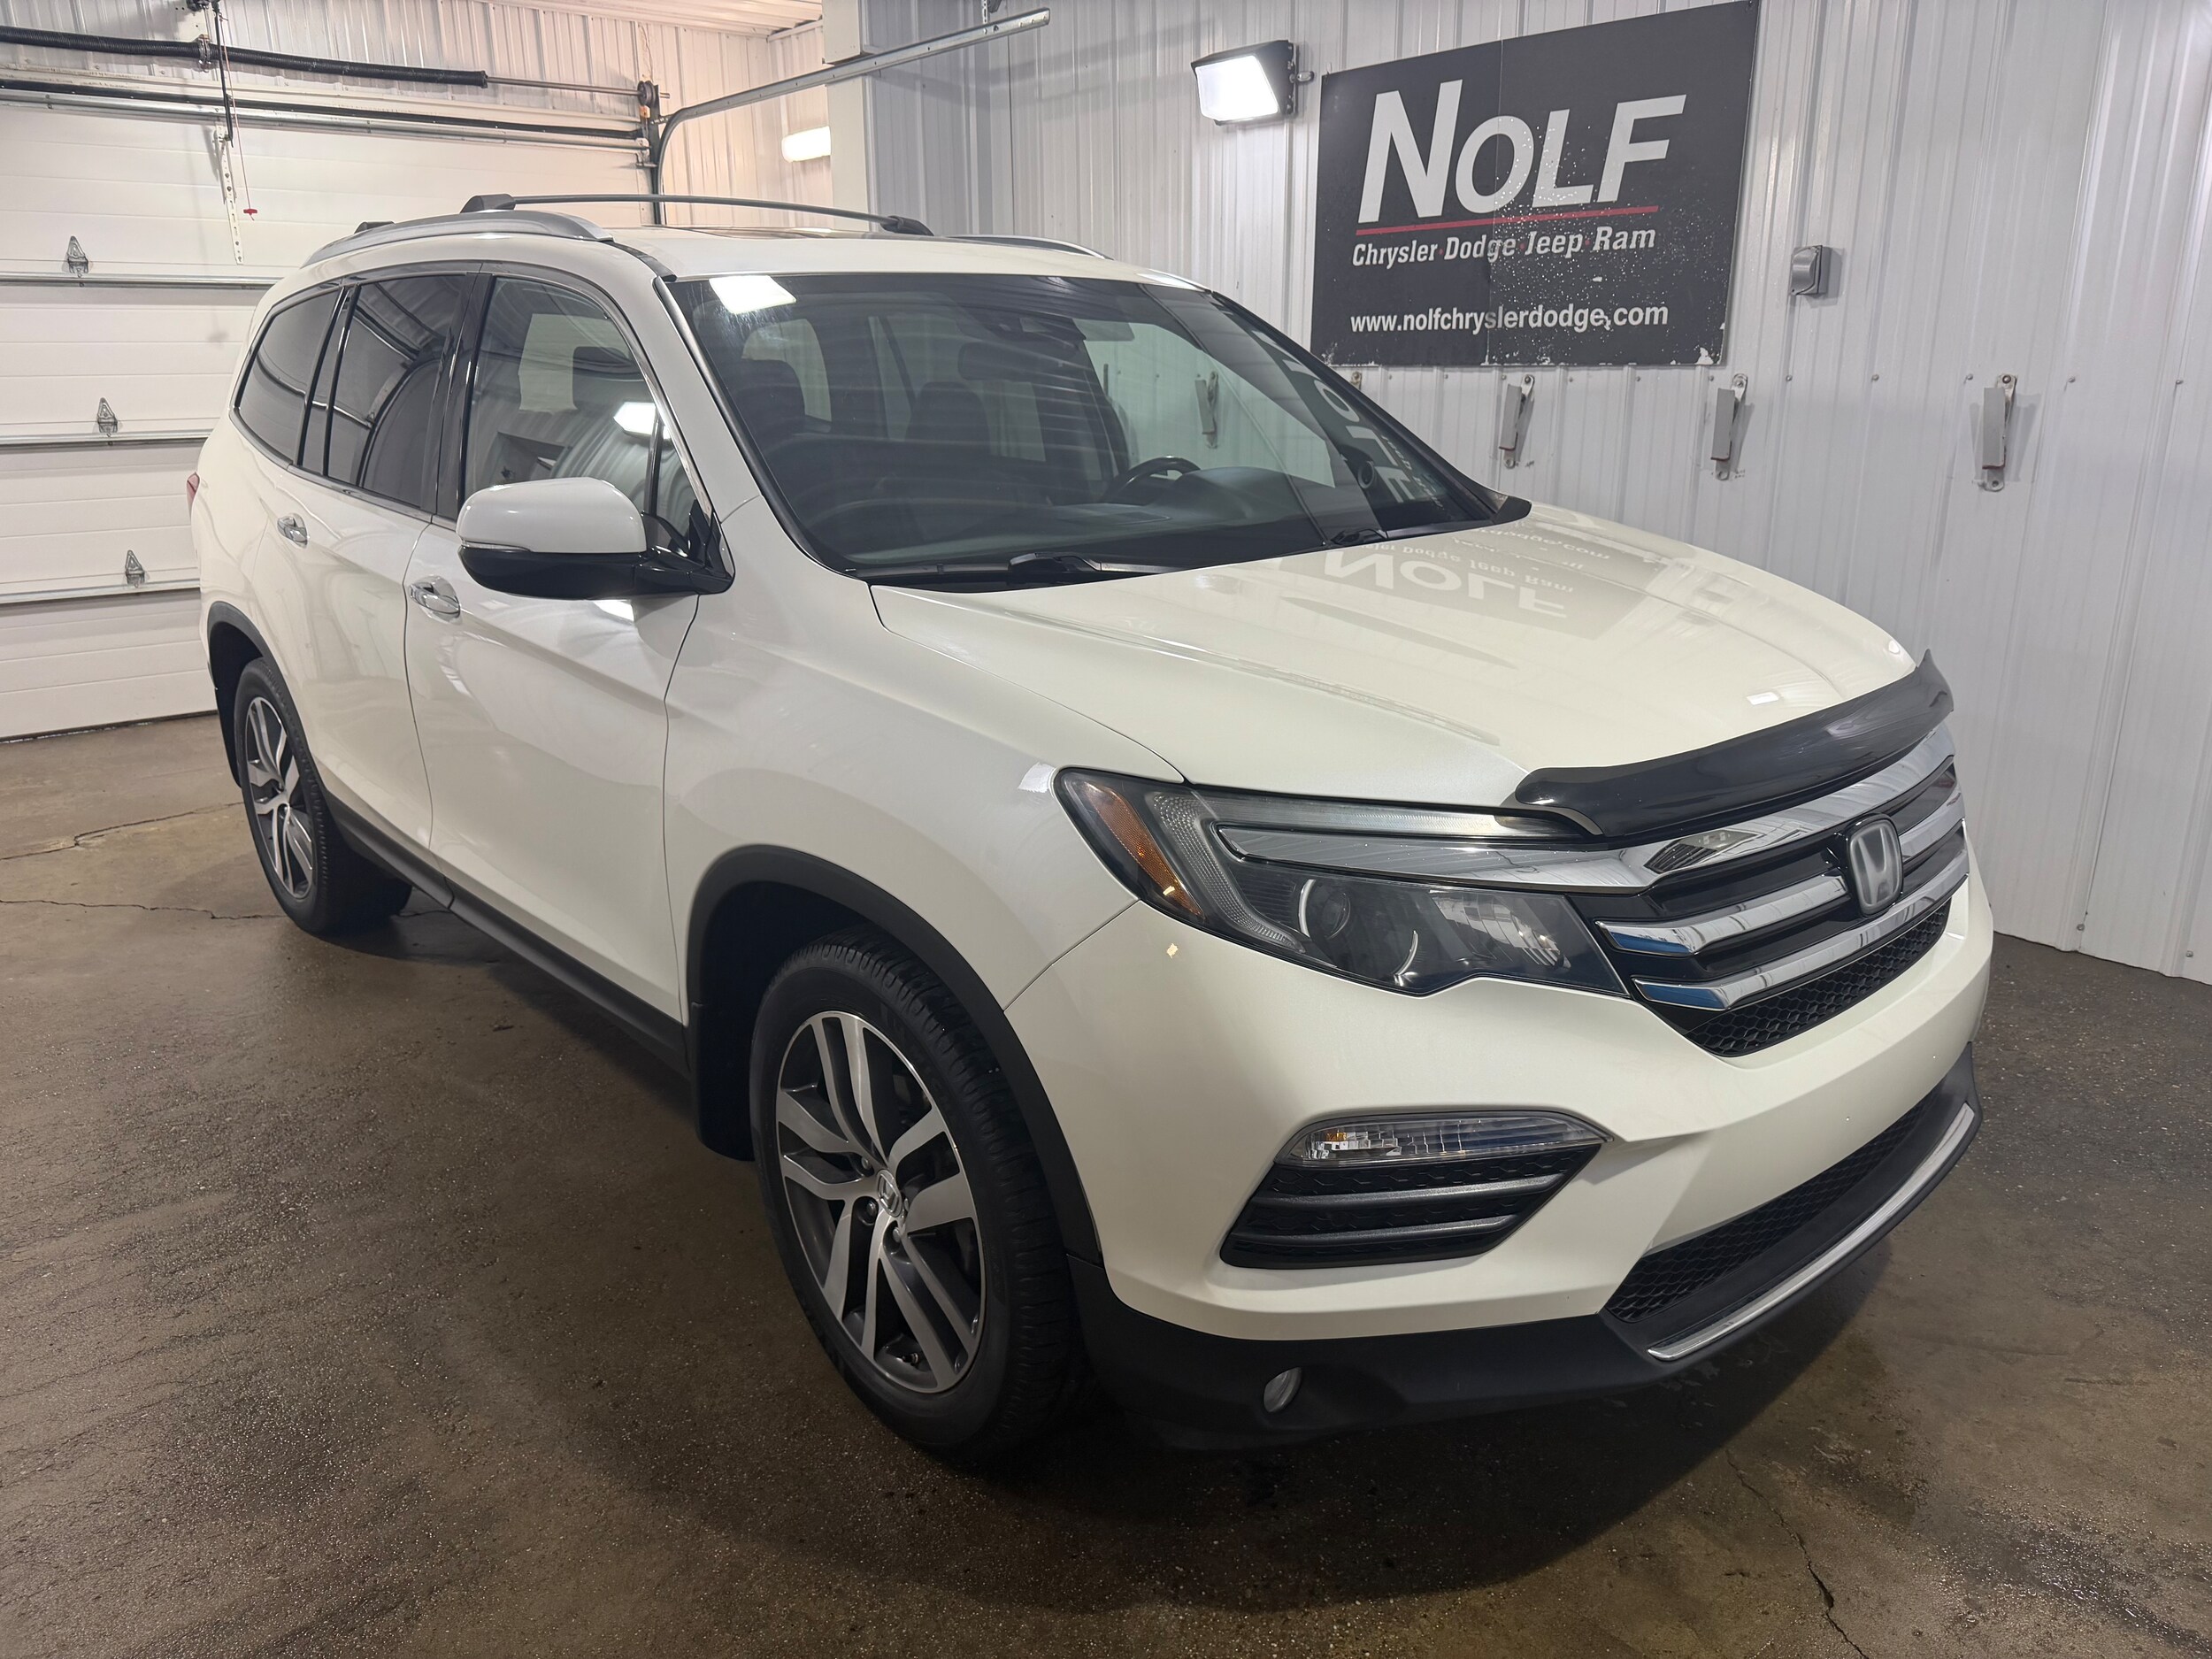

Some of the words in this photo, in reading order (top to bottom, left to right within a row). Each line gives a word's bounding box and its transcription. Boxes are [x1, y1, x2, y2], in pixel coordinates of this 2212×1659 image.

[1358, 79, 1686, 224] NOLF
[1352, 239, 1439, 269] Chrysler
[1444, 234, 1517, 262] Dodge
[1525, 231, 1583, 258] Jeep
[1593, 226, 1656, 251] Ram
[1350, 303, 1669, 334] www.nolfchryslerdodge.com
